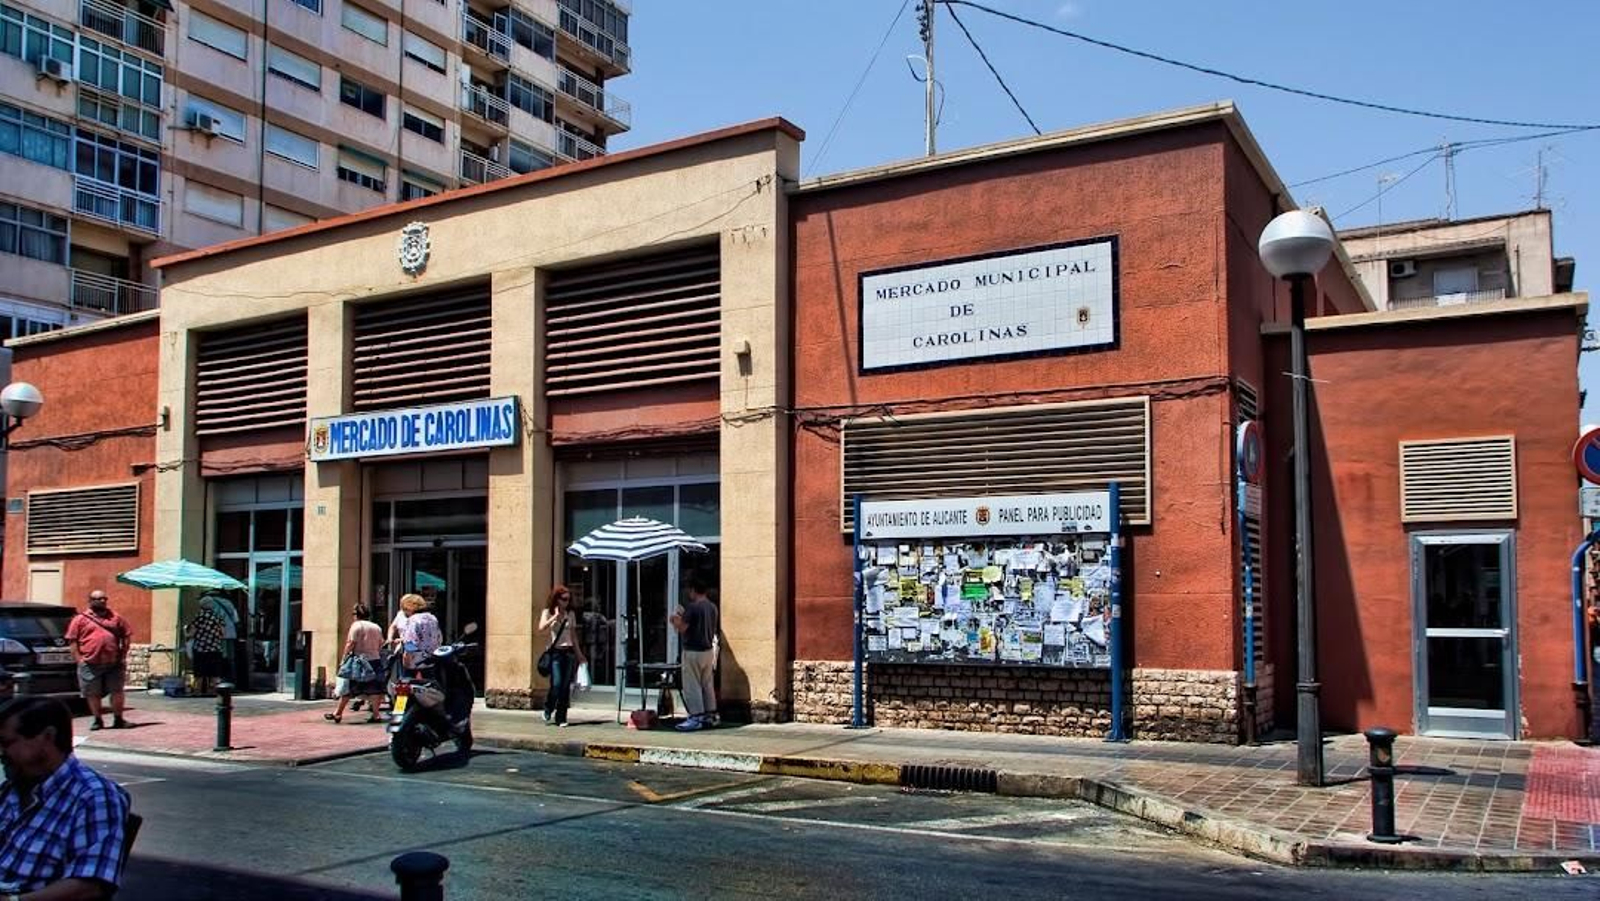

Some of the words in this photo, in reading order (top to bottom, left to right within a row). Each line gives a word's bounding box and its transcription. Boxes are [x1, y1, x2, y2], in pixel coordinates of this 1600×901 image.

[876, 279, 961, 300] MERCADO
[975, 260, 1096, 287] MUNICIPAL
[950, 304, 974, 318] DE
[913, 323, 1027, 348] CAROLINAS
[329, 416, 398, 454] MERCADO
[401, 414, 420, 447] DE
[424, 404, 513, 446] CAROLINAS
[867, 511, 918, 527] AYUNTAMIENTO
[921, 511, 931, 526] DE
[933, 510, 967, 525] ALICANTE
[999, 507, 1024, 523] PANEL
[1027, 507, 1049, 522] PARA
[1052, 504, 1102, 521] PUBLICIDAD
